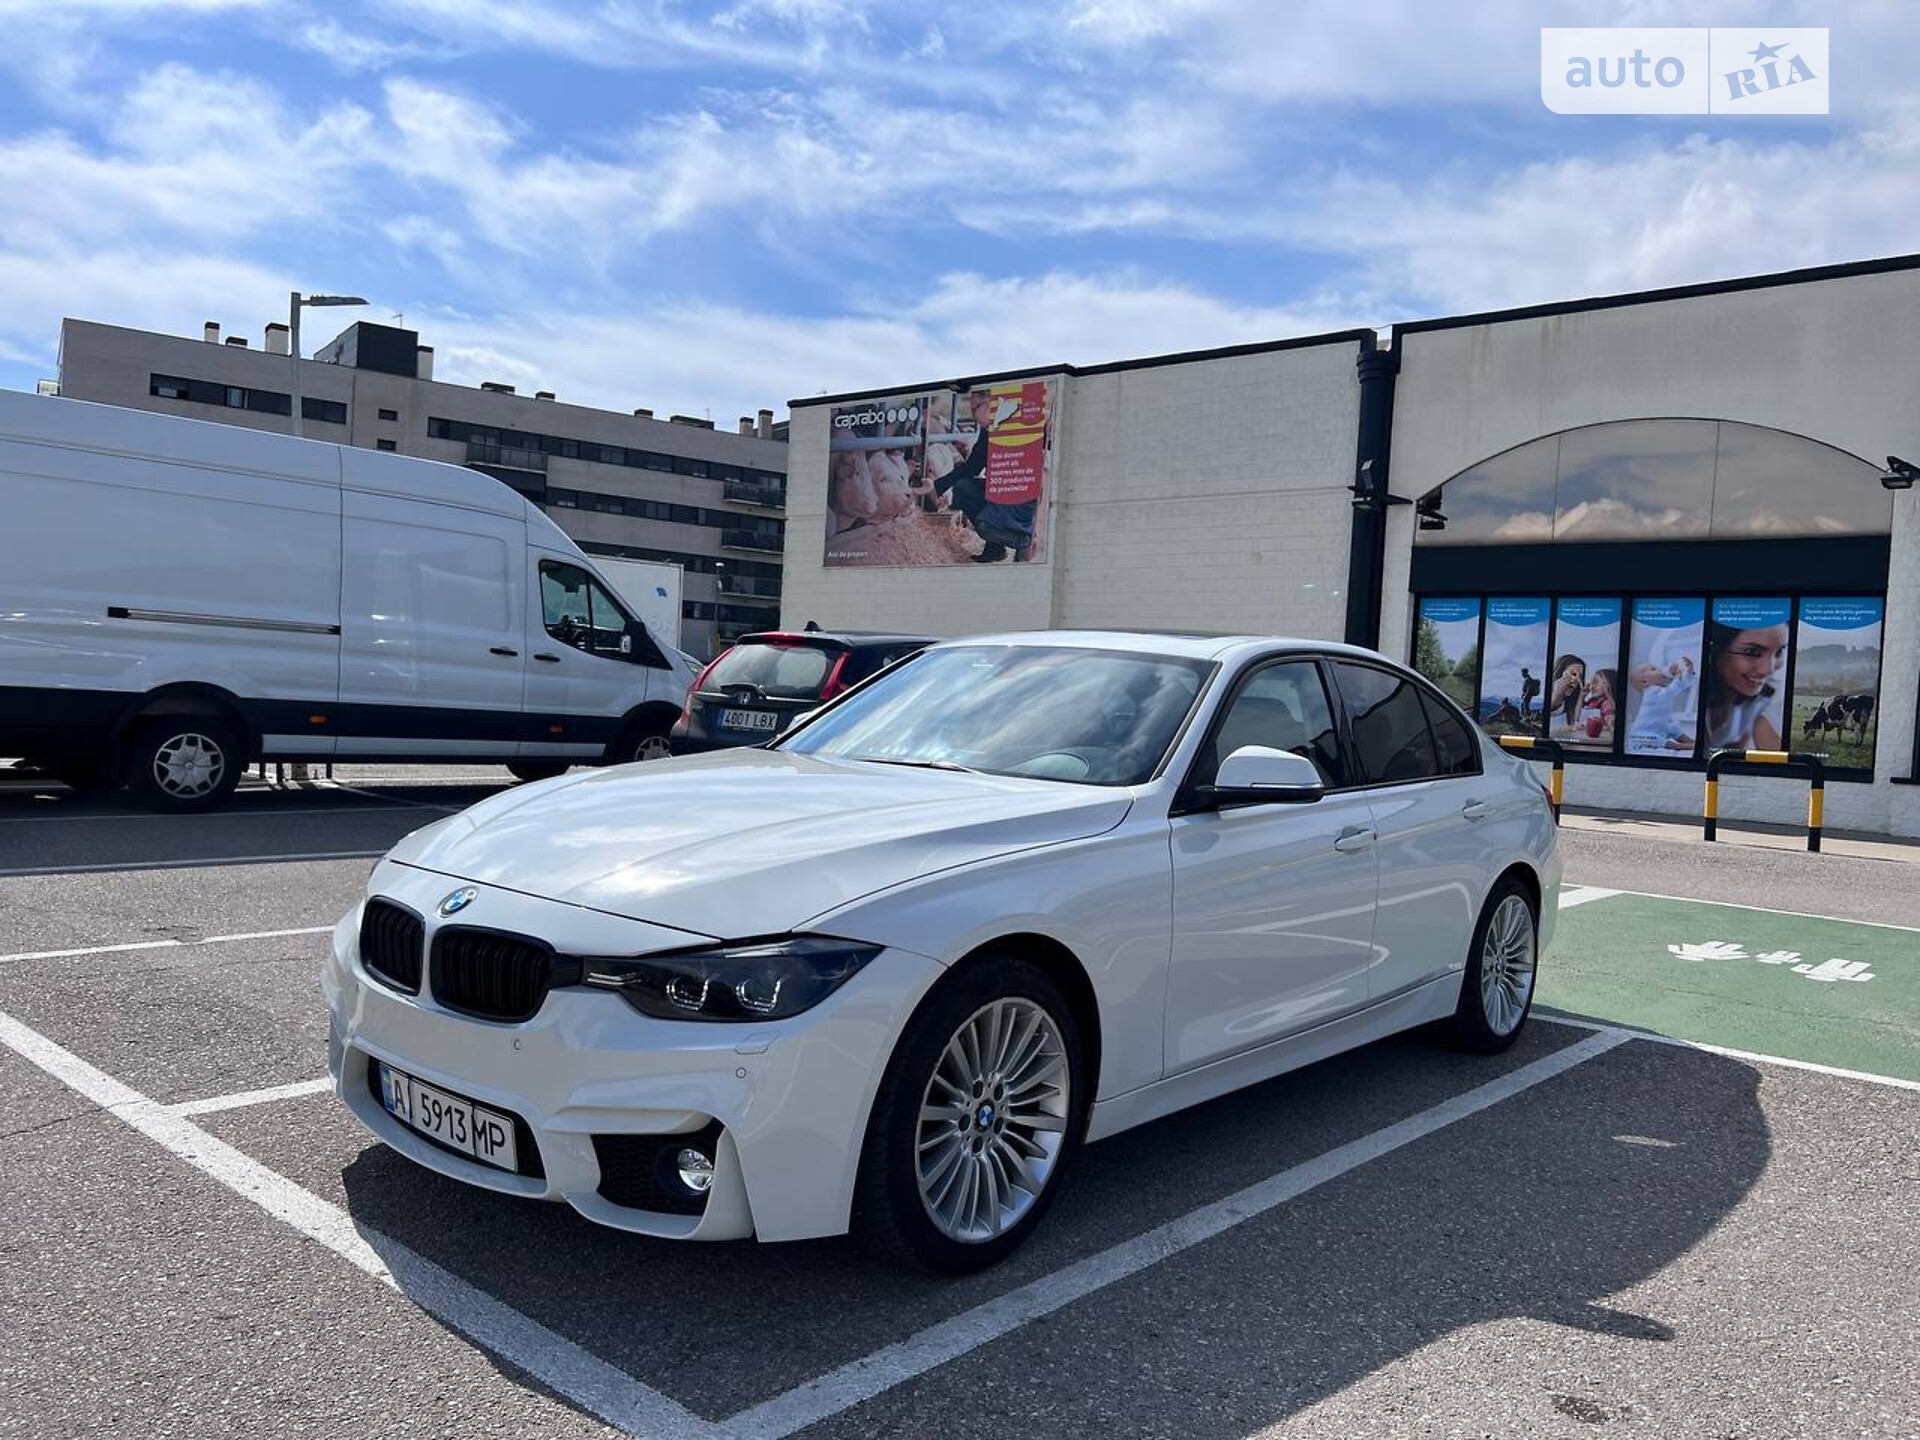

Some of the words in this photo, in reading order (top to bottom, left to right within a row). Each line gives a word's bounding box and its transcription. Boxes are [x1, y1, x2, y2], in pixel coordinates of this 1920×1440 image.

[834, 409, 886, 429] caprabo
[753, 713, 774, 729] LBX
[420, 1092, 467, 1144] 5913
[471, 1112, 506, 1156] MP
